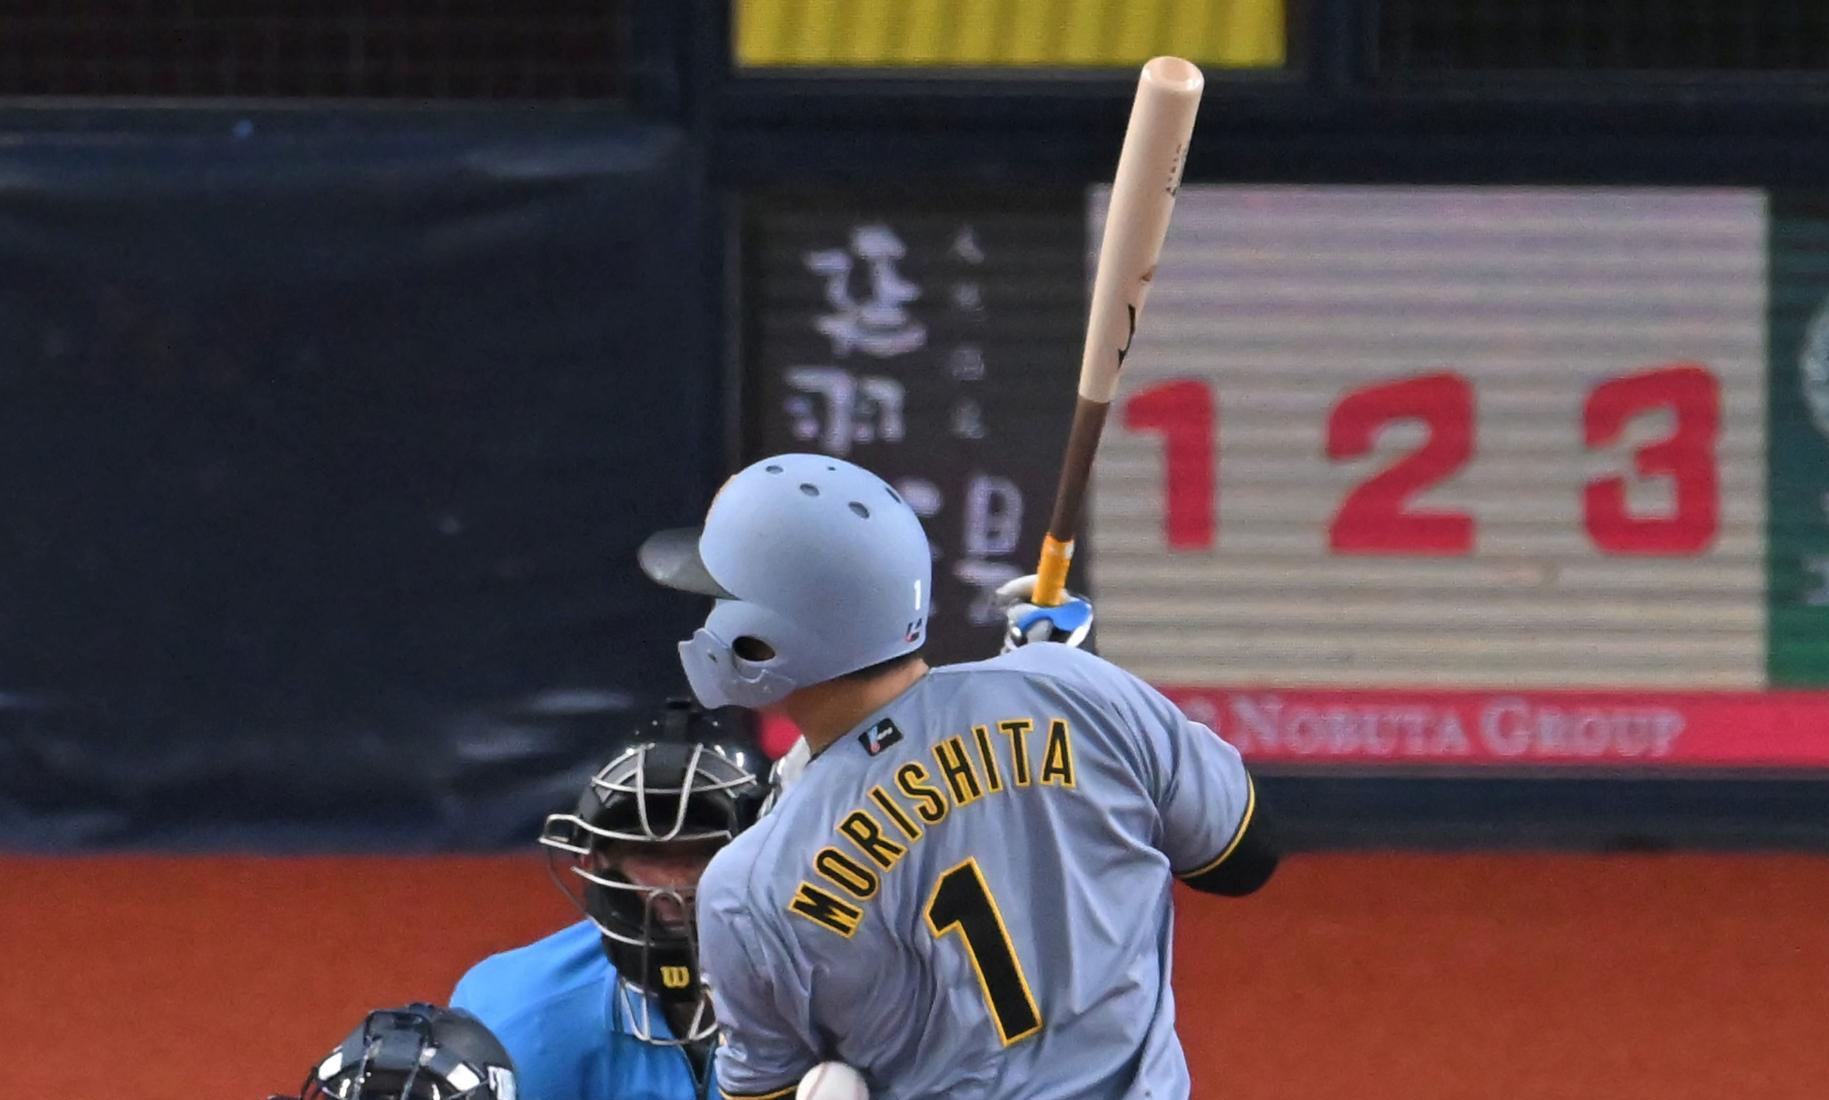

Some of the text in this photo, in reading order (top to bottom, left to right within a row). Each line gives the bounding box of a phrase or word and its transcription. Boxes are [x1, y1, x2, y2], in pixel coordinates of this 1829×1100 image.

[1123, 378, 1216, 552] 1
[1327, 371, 1475, 555] 2
[1582, 363, 1722, 556] 3
[913, 579, 922, 611] 1
[788, 717, 1078, 938] MORISHITA
[923, 856, 1044, 1047] 1
